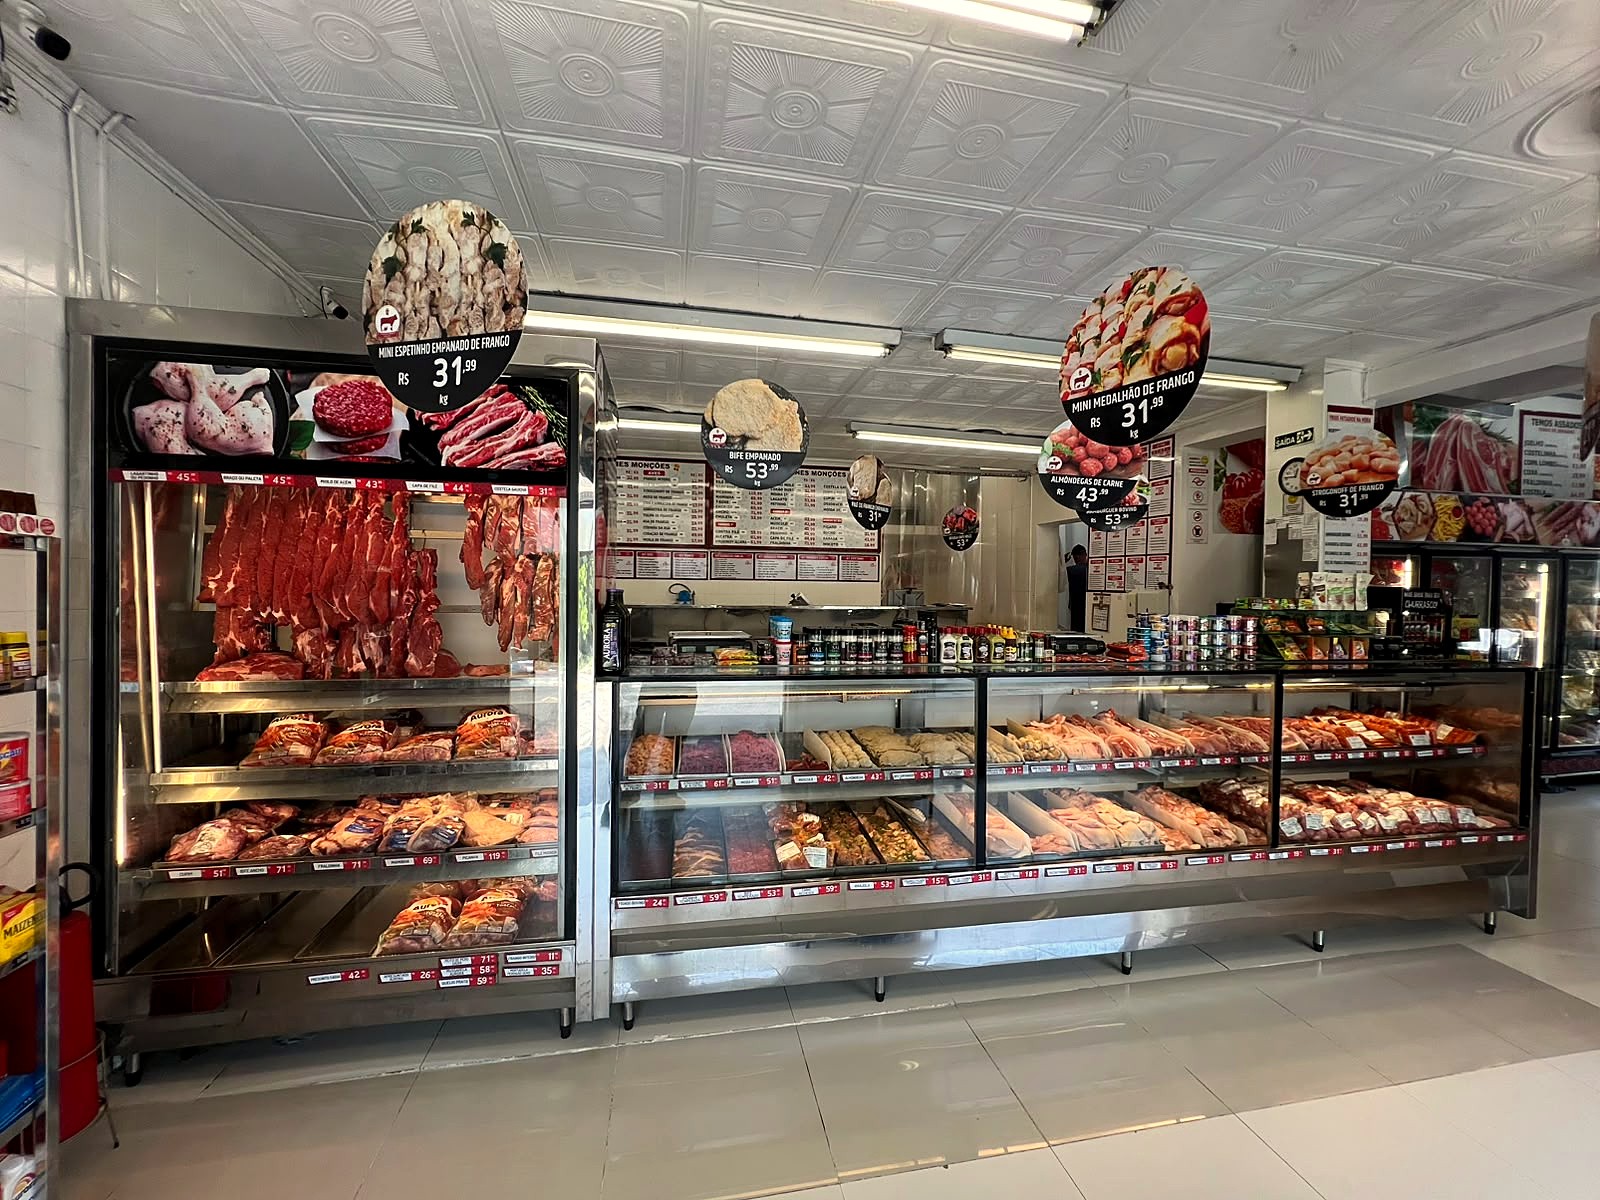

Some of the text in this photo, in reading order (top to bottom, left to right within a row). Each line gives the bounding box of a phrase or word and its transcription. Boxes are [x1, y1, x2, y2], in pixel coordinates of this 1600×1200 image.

[379, 335, 510, 358] MINI ESPETINHO EMPANADO DE FRANGO
[1072, 370, 1194, 414] MINI MEDALHÃO DE FRANGO
[440, 394, 448, 406] kg
[1130, 429, 1139, 439] kg
[1275, 436, 1295, 448] SAÍDA
[729, 451, 781, 462] BIFE EMPANADO
[176, 473, 190, 481] 45
[811, 470, 846, 478] MONÇÕES
[272, 476, 286, 484] 45
[1050, 475, 1124, 488] ALMÔNDEGAS DE CARNE
[453, 484, 464, 492] 44
[1312, 486, 1348, 496] STROGONOFF
[1359, 484, 1384, 492] FRANGO
[471, 710, 503, 722] Aurora
[488, 852, 500, 860] 119
[481, 955, 490, 963] 71
[349, 971, 360, 979] 42
[480, 966, 490, 974] 58
[542, 967, 552, 975] 35
